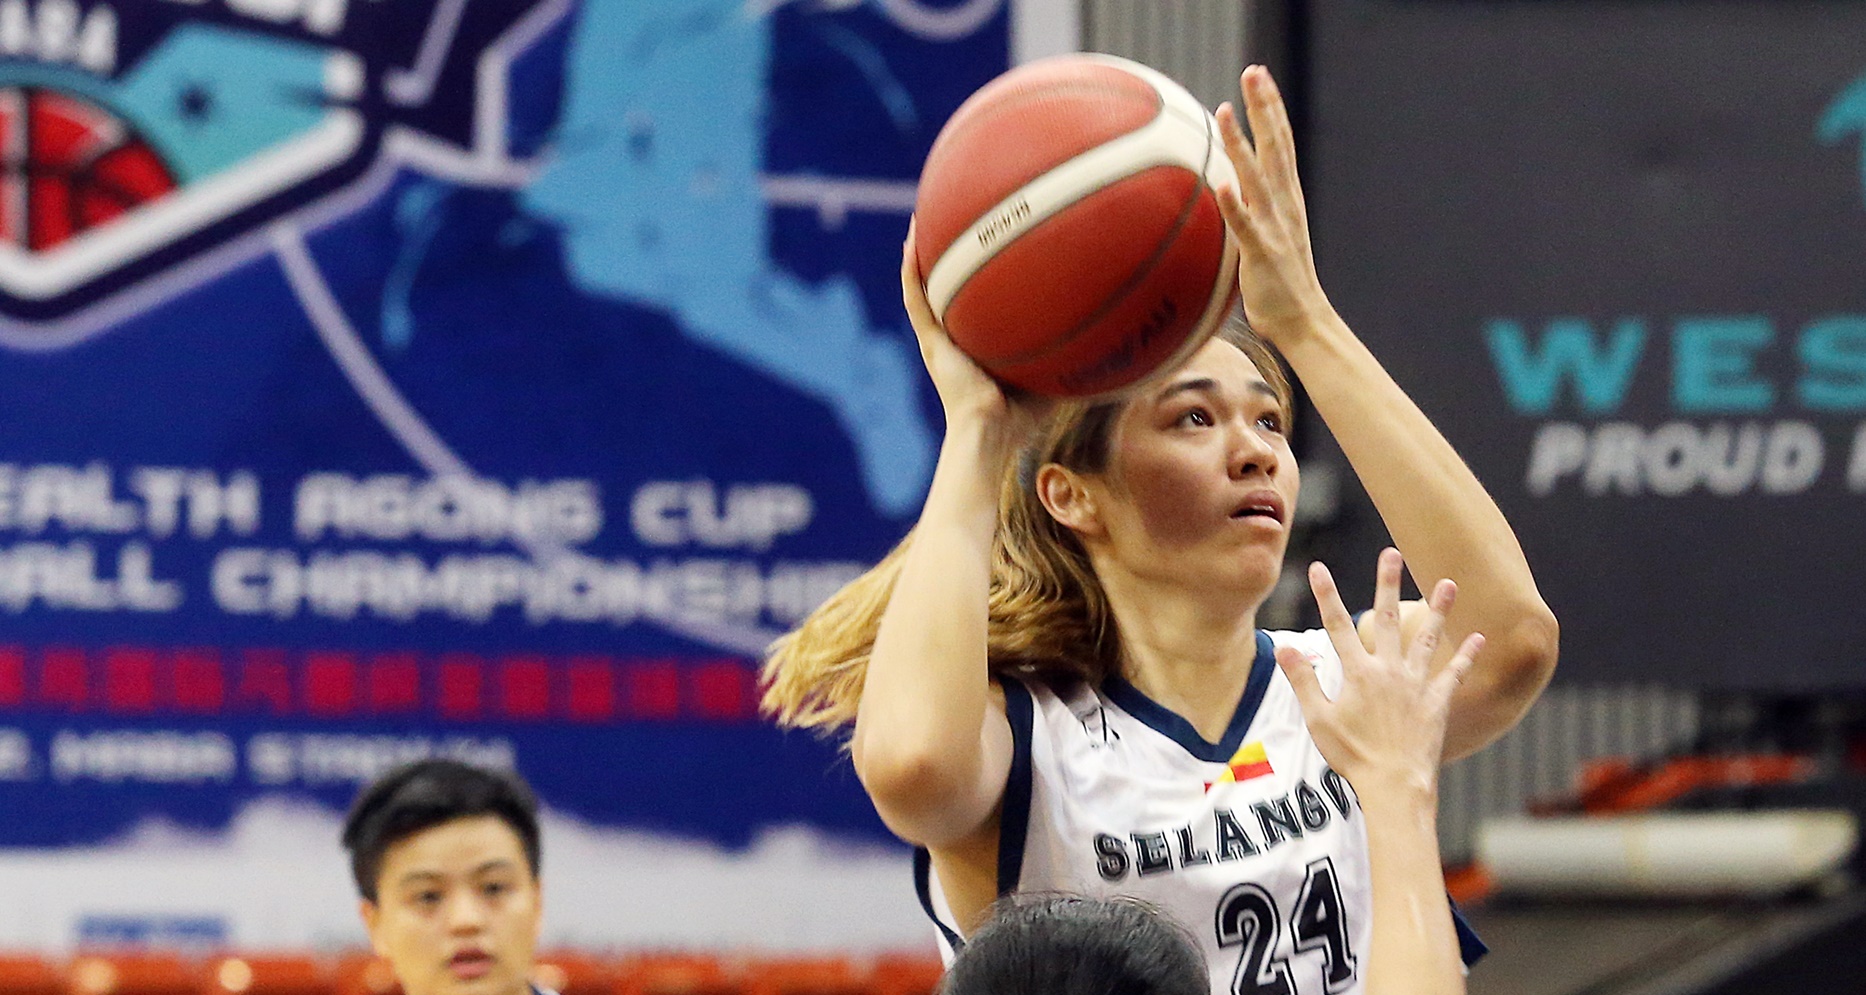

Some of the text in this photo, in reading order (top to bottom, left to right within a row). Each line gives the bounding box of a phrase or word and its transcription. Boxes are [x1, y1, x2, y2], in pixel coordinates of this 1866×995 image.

[1483, 316, 1866, 415] WES
[1526, 420, 1825, 495] PROUD
[632, 480, 815, 551] CUP
[1094, 765, 1363, 882] SELANGO
